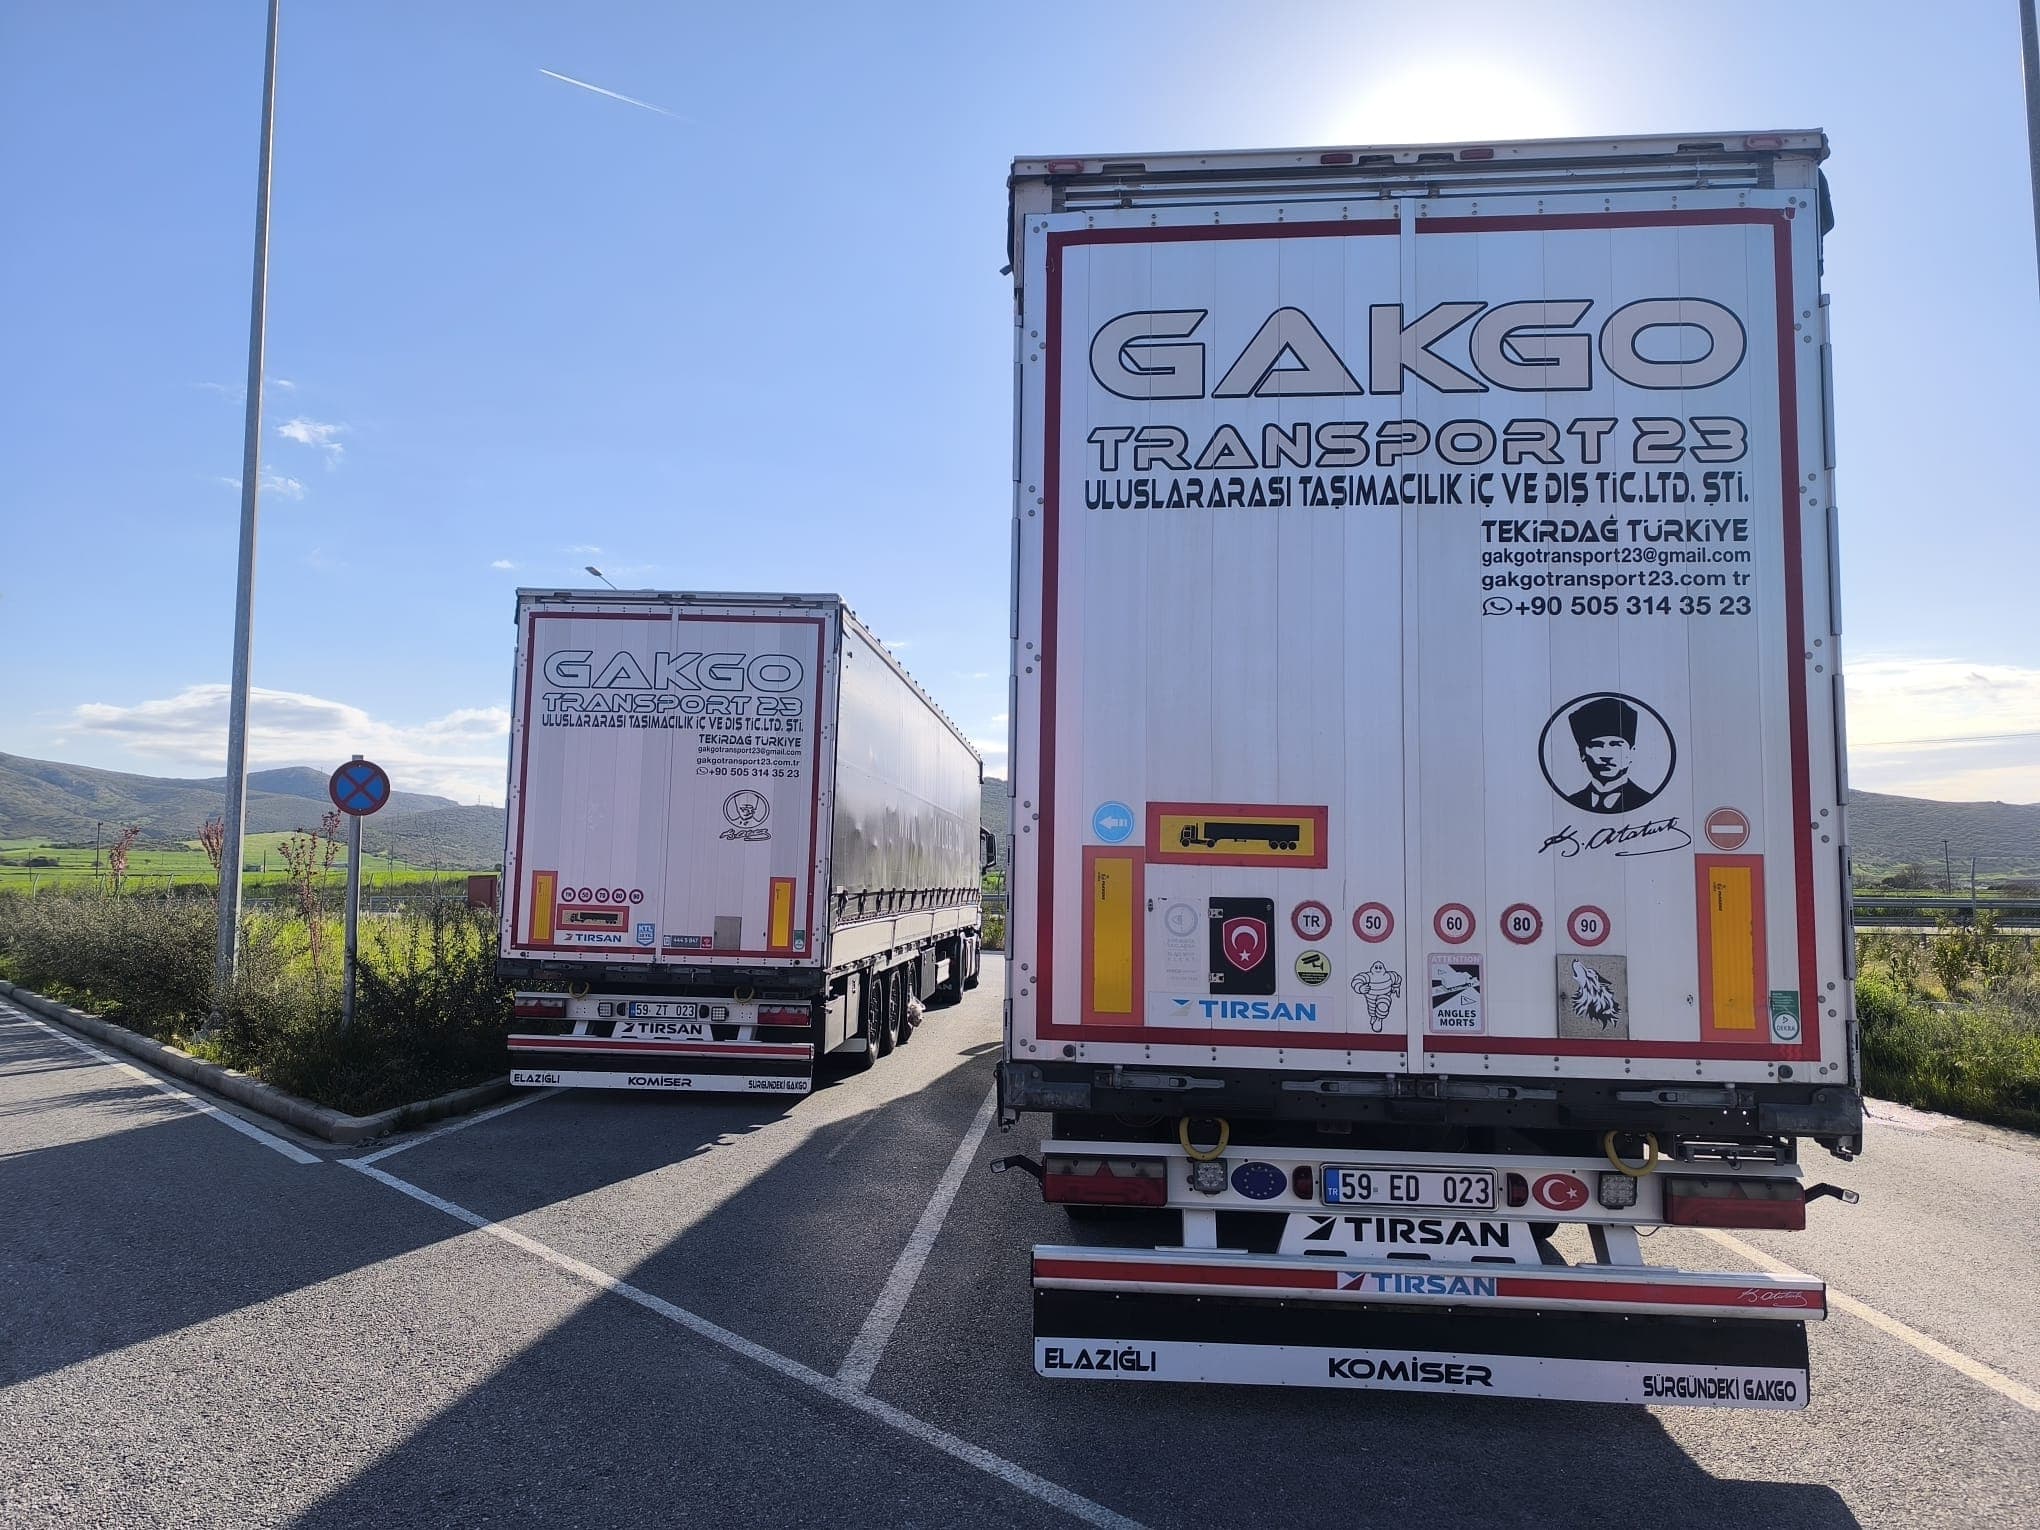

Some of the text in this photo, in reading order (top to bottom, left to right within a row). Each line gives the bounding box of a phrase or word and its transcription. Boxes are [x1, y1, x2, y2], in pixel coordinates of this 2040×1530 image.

[1088, 297, 1748, 400] GAKGO
[1087, 415, 1749, 473] TRANSPORT 23
[1085, 475, 1292, 510] ULUSLARARASI
[1298, 472, 1463, 509] TAŞIMACILIK
[1500, 473, 1538, 504] VE
[1545, 472, 1589, 507] DIŞ
[1481, 547, 1751, 567] gakgotransport23@gmail.com
[1481, 570, 1751, 591] gakgotransport23.com tr
[1515, 596, 1752, 616] +90 505 314 35 23
[543, 650, 804, 692] GAKGO
[542, 692, 803, 717] TRANSPORT 23
[542, 713, 627, 728] ULUSLARARASI
[709, 717, 723, 731] VE
[698, 746, 802, 757] gakgotransport23@gmail.com
[696, 756, 800, 767] gakgotransport23.com.tr
[709, 767, 800, 778] +90 505 314 35 23
[1302, 914, 1321, 929] TR
[1365, 915, 1382, 931] 50
[1446, 916, 1463, 932] 60
[1513, 916, 1531, 932] 80
[1580, 918, 1597, 934] 90
[575, 933, 622, 943] TIRSAN
[636, 1004, 694, 1017] 59 ZT 023
[1199, 999, 1317, 1022] TIRSAN
[1438, 1009, 1477, 1018] ANGLES
[638, 1022, 703, 1035] TIRSAN
[1440, 1018, 1475, 1027] MORTS
[1328, 1187, 1338, 1197] TR
[1341, 1173, 1490, 1204] 59 ED 023
[1344, 1216, 1510, 1248] TIRSAN
[1371, 1272, 1496, 1297] TIRSAN
[1328, 1355, 1494, 1388] KOMİSER
[1643, 1372, 1797, 1402] SÜRGÜNDEKİ GAKGO
